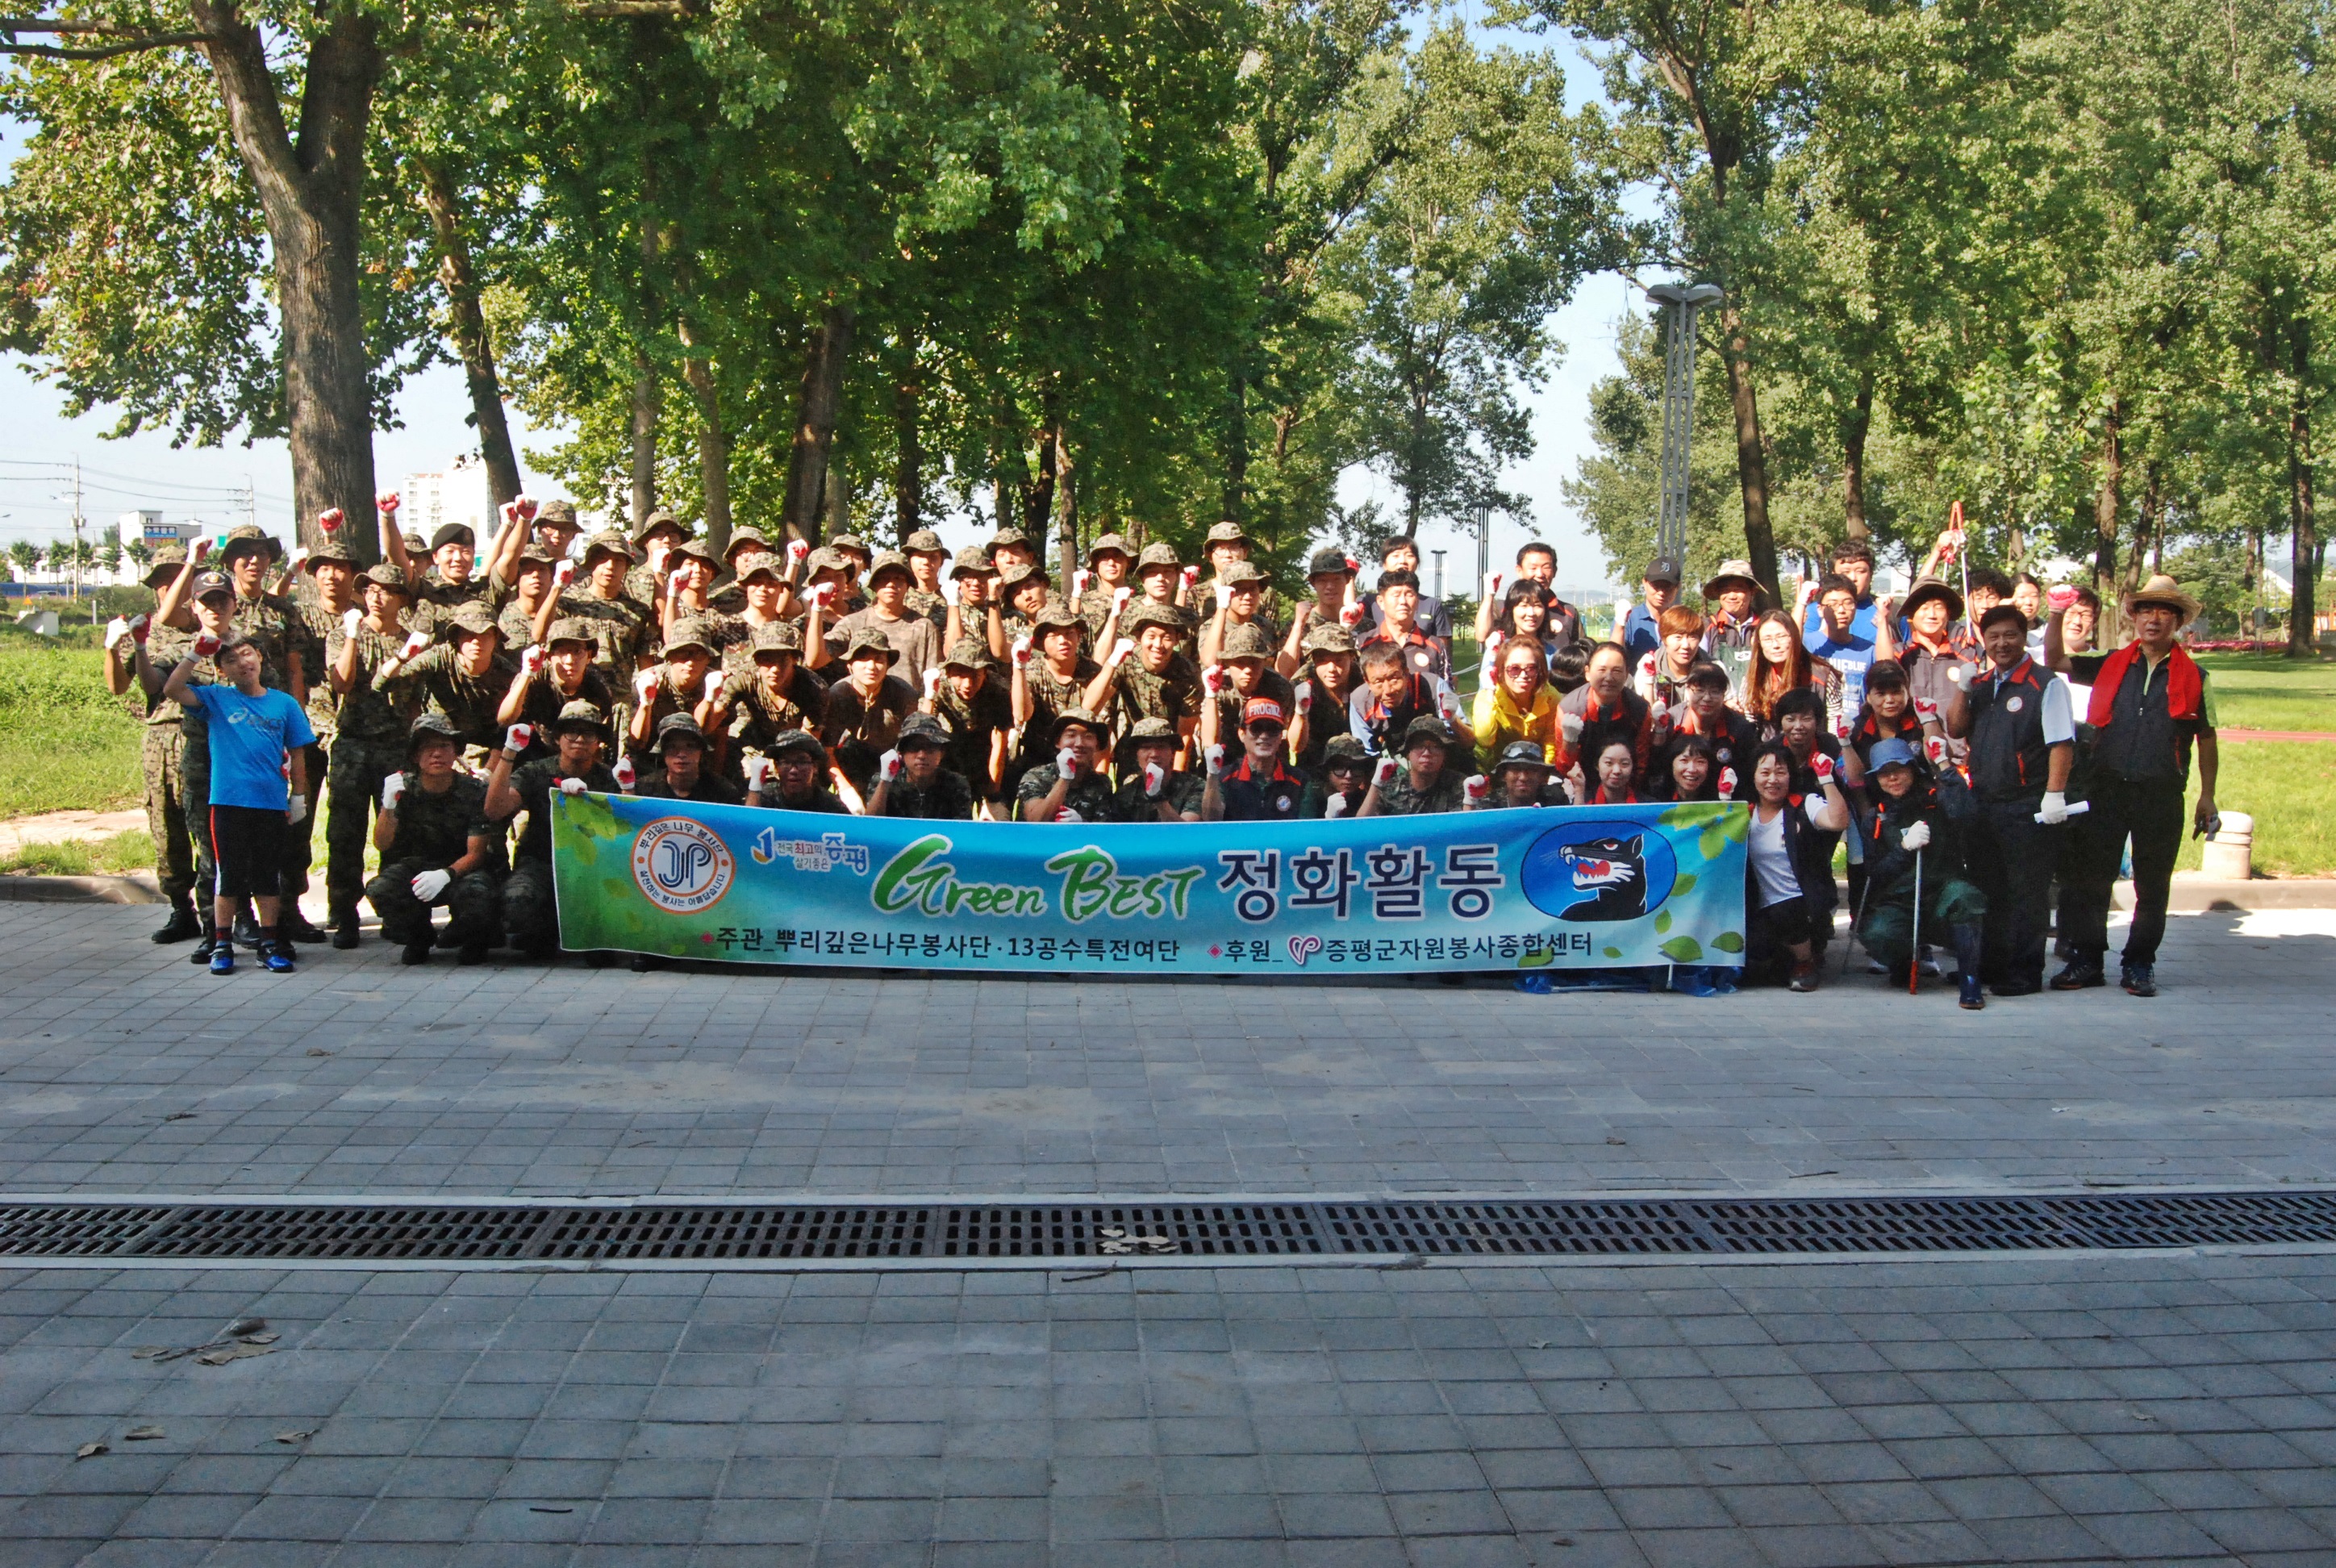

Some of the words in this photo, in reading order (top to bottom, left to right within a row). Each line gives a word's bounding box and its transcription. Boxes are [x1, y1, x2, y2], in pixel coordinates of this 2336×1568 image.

[1847, 661, 1867, 672] BLUE
[640, 823, 670, 849] 뿌리깊은
[674, 822, 694, 832] 나무
[697, 828, 724, 853] 봉사단
[874, 836, 1046, 916] Green
[1218, 845, 1503, 922] 정화활동
[1325, 932, 1593, 962] 증평군자원봉사종합센터
